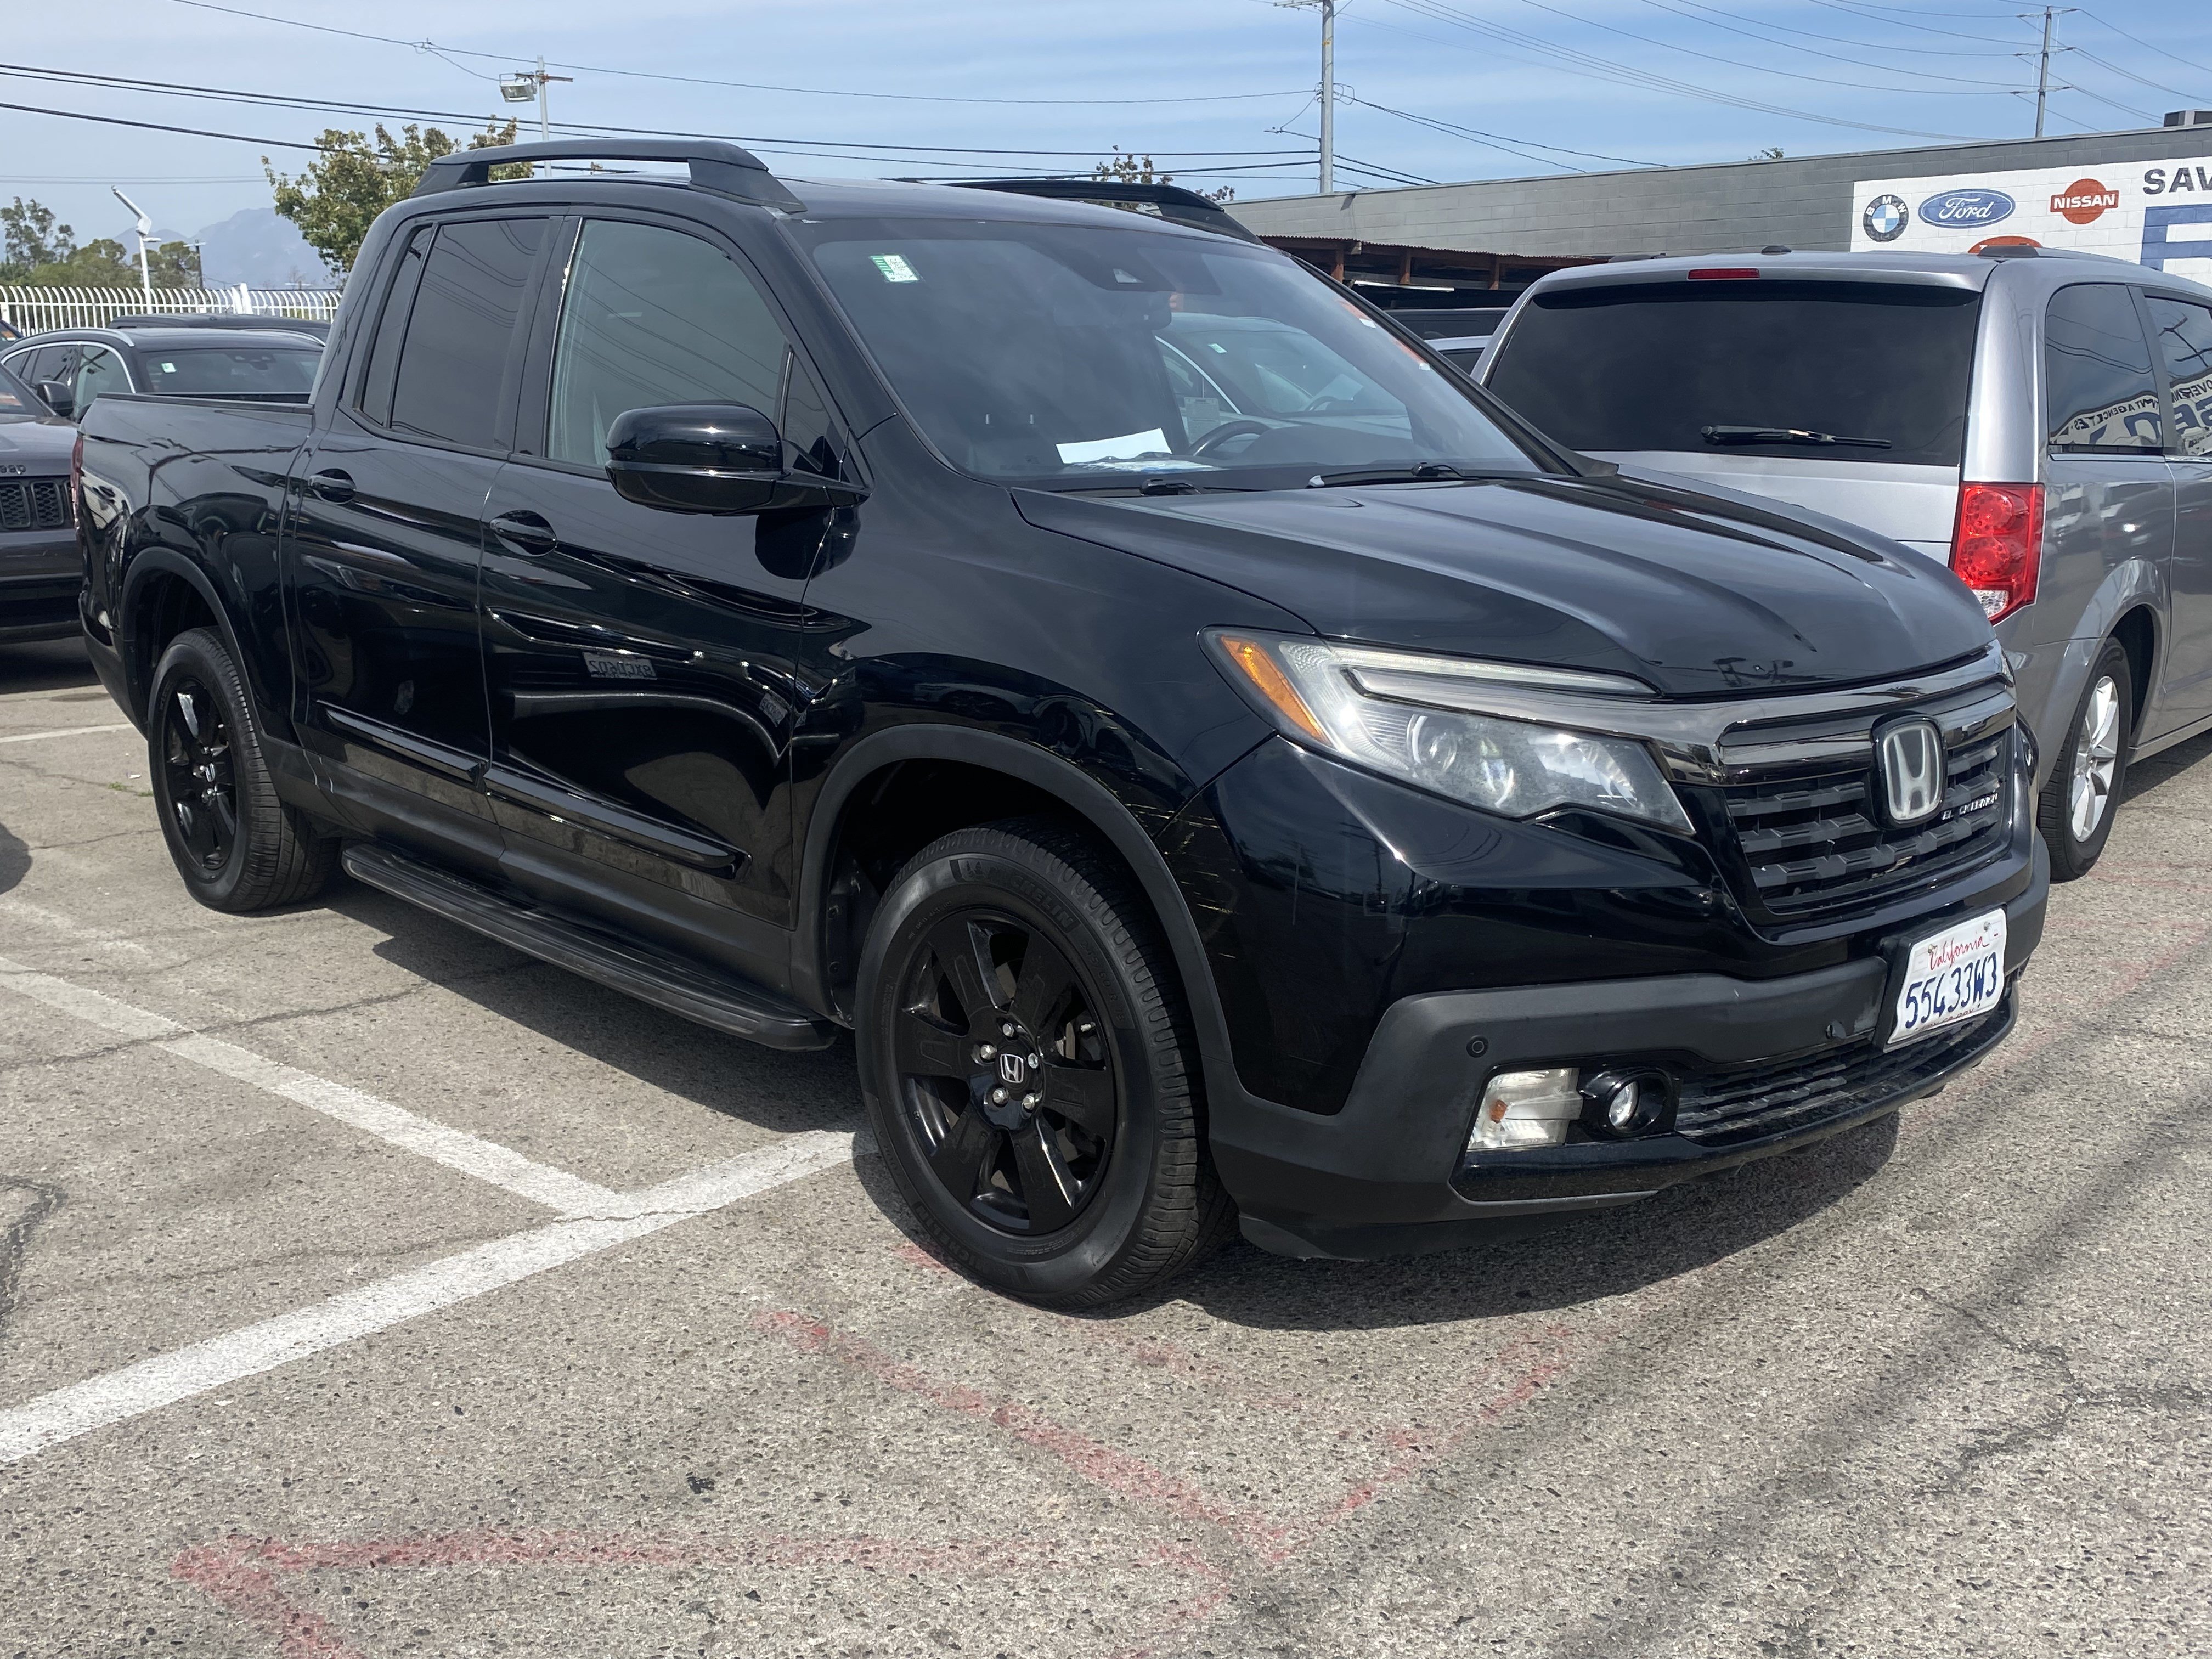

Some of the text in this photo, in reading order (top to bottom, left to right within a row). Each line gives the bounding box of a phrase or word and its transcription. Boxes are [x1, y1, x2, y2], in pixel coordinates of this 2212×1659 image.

[1865, 195, 1907, 216] BMW
[1939, 197, 1995, 219] Ford
[2053, 194, 2115, 210] NISSAN
[1929, 935, 1990, 970] California
[1905, 952, 1997, 1029] 55433W3
